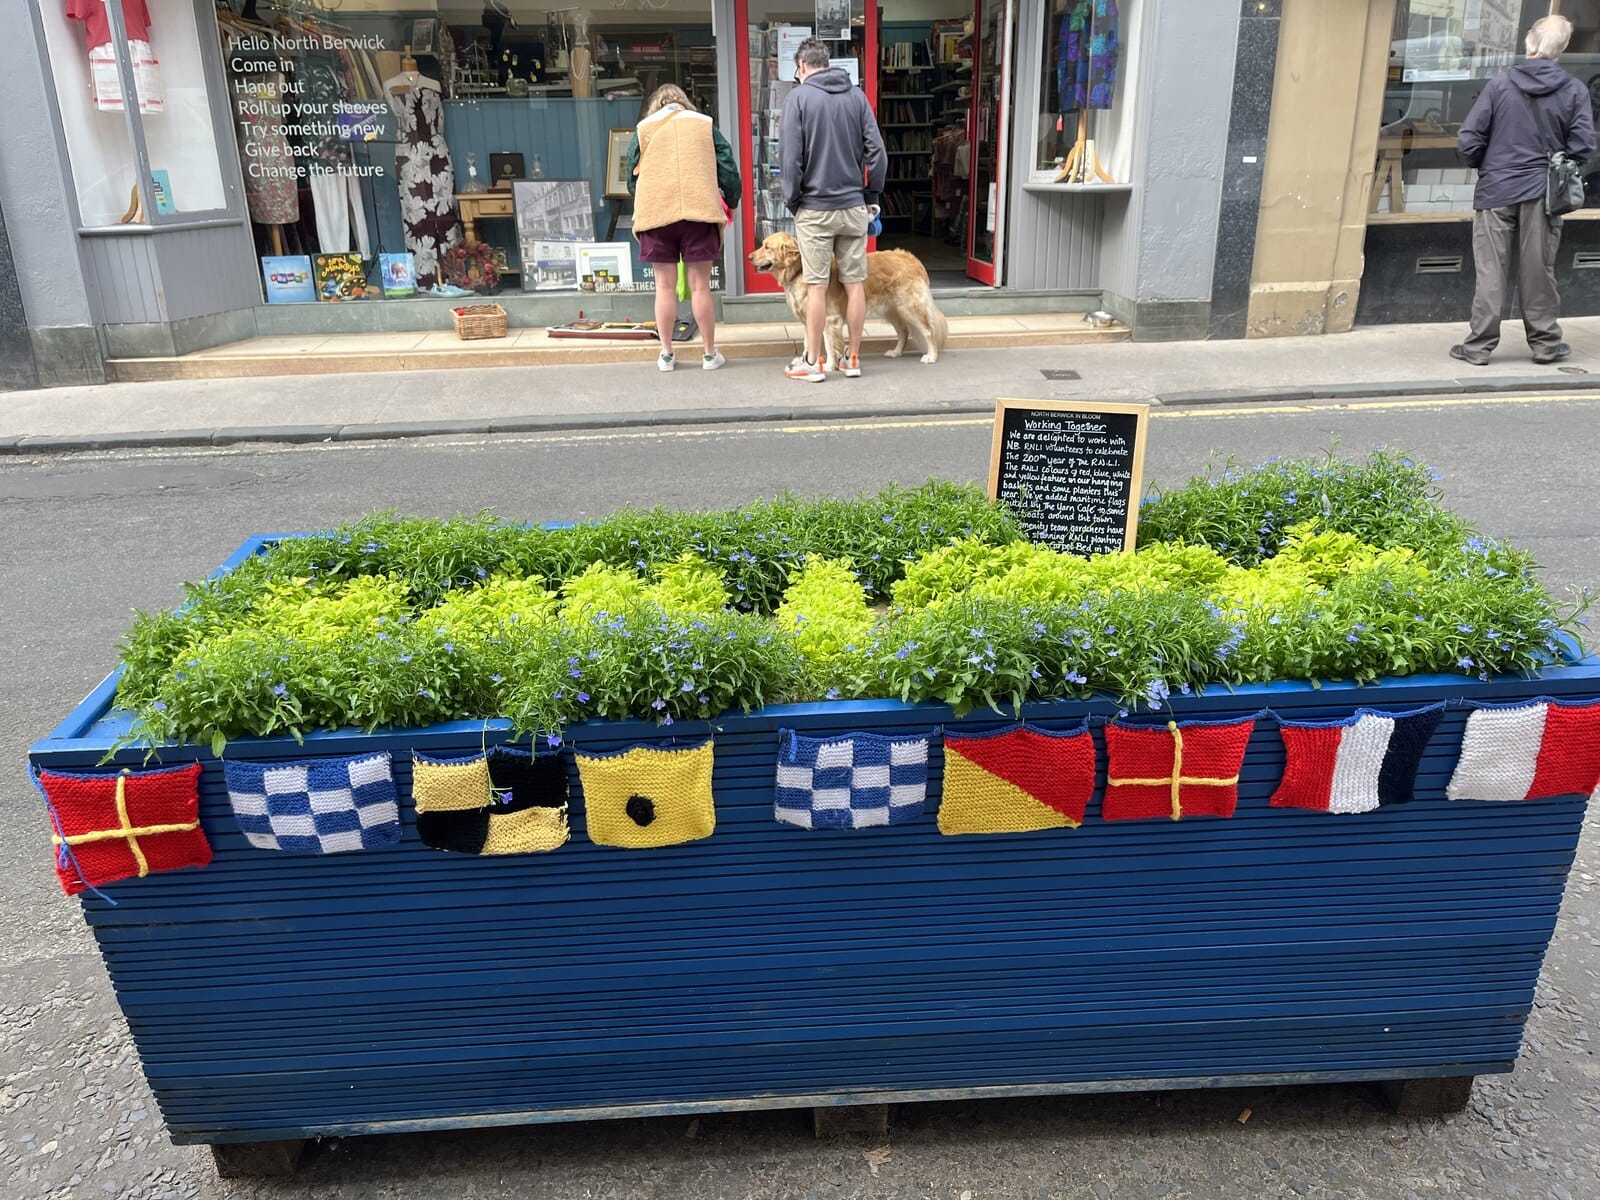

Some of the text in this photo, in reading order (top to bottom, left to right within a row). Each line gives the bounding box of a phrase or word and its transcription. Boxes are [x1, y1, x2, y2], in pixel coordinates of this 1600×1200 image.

[228, 34, 386, 51] Hello North Berwick
[231, 56, 295, 72] Come in
[234, 78, 306, 97] Hang out
[238, 99, 388, 118] Roll up your sleeves
[240, 120, 385, 139] Try something new
[245, 141, 319, 157] Give back
[248, 161, 385, 180] Change the future
[1025, 419, 1107, 436] Working Together
[1010, 430, 1021, 439] We
[1037, 433, 1075, 447] delighted
[1077, 435, 1086, 443] to
[1087, 436, 1107, 444] work
[1109, 434, 1126, 446] with
[1024, 442, 1043, 451] RNLI
[1045, 443, 1083, 455] volunteers
[1085, 446, 1093, 455] to
[1095, 446, 1129, 456] celebrate
[1004, 461, 1019, 471] The
[1021, 464, 1039, 472] RNLI
[1041, 466, 1069, 475] colours
[1070, 468, 1078, 477] of
[1112, 470, 1131, 479] white
[1047, 457, 1066, 468] year
[1068, 457, 1075, 468] of
[1003, 471, 1017, 479] and
[1018, 472, 1040, 482] yellow
[1040, 473, 1067, 485] feature
[1091, 477, 1123, 491] hanging
[1035, 483, 1050, 491] and
[1051, 485, 1071, 493] some
[1073, 486, 1102, 496] planters
[1030, 500, 1041, 511] by
[1042, 502, 1055, 511] The
[1056, 502, 1074, 514] Yarn
[1106, 508, 1126, 516] some
[1045, 492, 1068, 501] added
[1069, 495, 1106, 505] maritime
[1107, 497, 1127, 509] flags
[1047, 512, 1075, 521] around
[1050, 523, 1069, 532] team
[1106, 525, 1124, 535] have
[1076, 542, 1092, 553] Bed
[1094, 544, 1102, 553] in
[1091, 534, 1122, 548] planting
